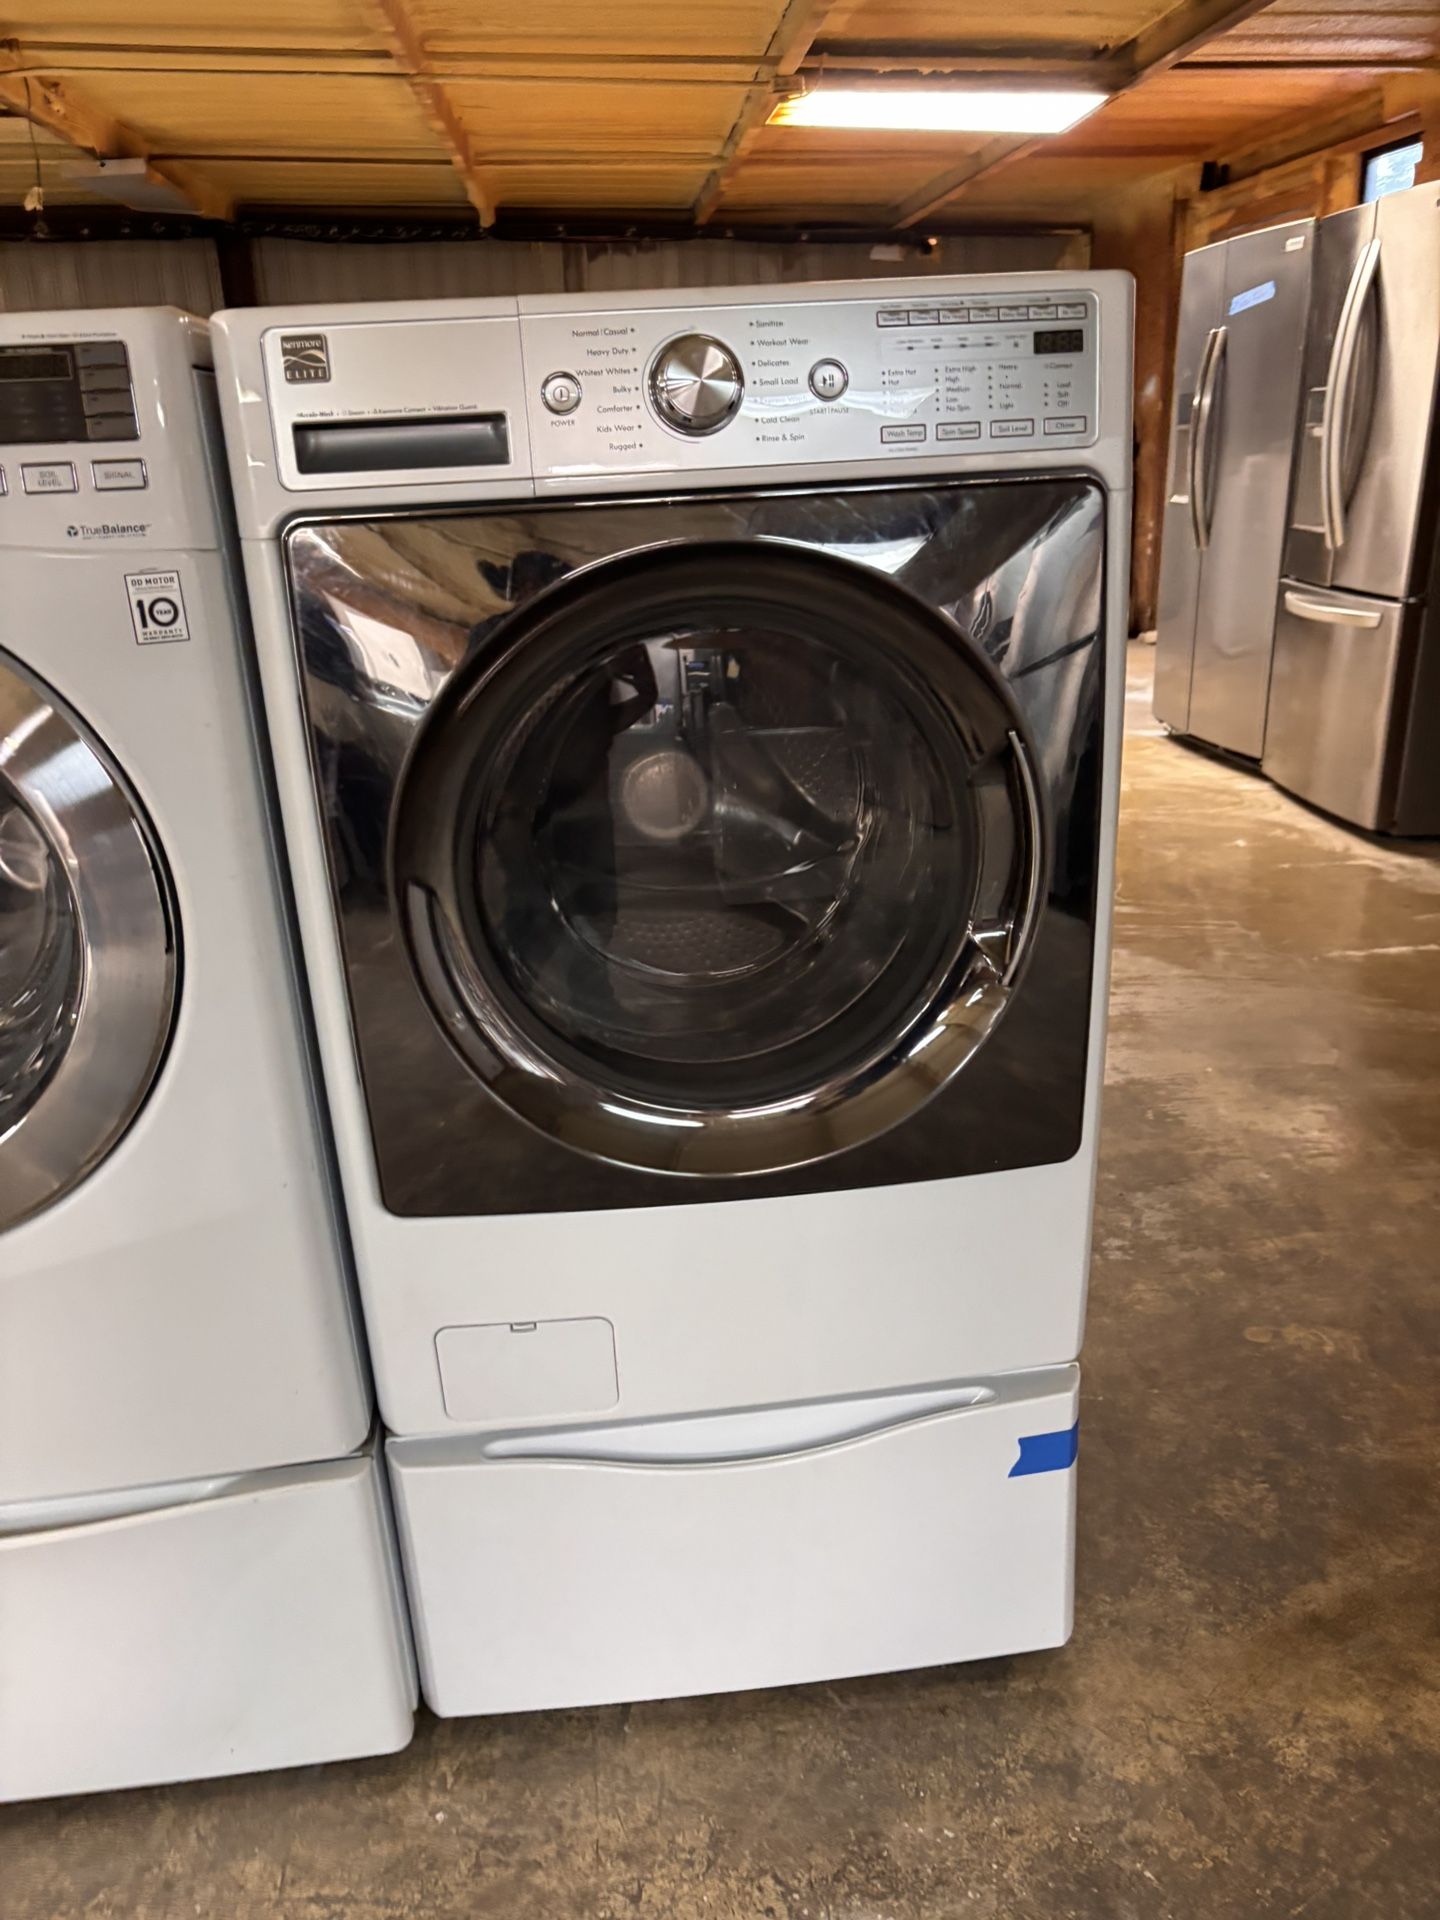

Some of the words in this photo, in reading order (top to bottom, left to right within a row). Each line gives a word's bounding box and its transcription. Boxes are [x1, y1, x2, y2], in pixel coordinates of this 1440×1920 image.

[756, 320, 784, 328] Sanitize
[757, 338, 787, 347] Workout
[788, 337, 809, 346] Wear
[587, 349, 610, 357] Heavy
[612, 347, 628, 356] Duty
[286, 368, 324, 379] ELITE
[576, 368, 603, 377] Whitest
[605, 367, 630, 375] Whites
[759, 378, 779, 386] Small
[781, 377, 799, 385] Load
[612, 386, 631, 394] Bulky
[597, 405, 632, 413] Comforter
[761, 416, 777, 424] Cold
[779, 416, 800, 424] Clean
[596, 425, 612, 433] Kids
[614, 423, 634, 432] Wear
[762, 434, 780, 442] Rinse
[781, 433, 788, 441] &
[789, 433, 805, 442] Spin
[609, 442, 636, 451] Rugged
[103, 471, 135, 480] SIGNAL
[145, 576, 175, 585] MOTOR
[136, 597, 179, 628] 10
